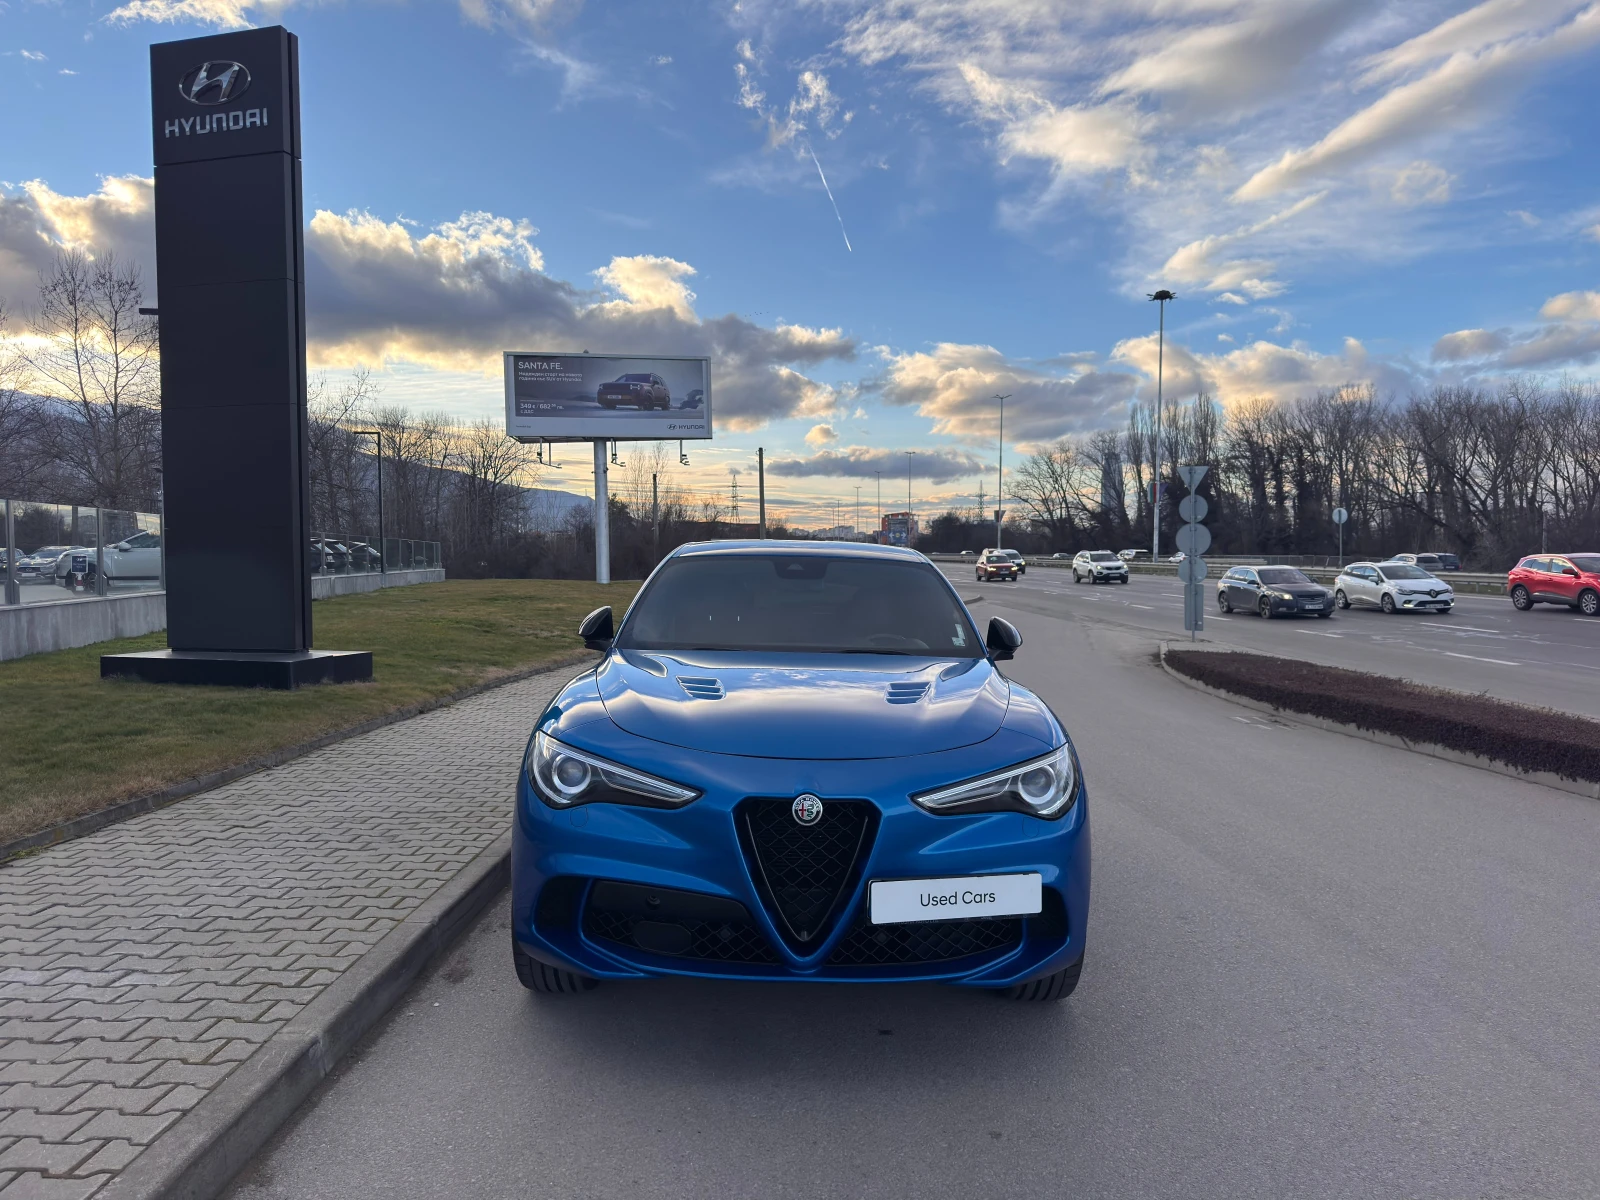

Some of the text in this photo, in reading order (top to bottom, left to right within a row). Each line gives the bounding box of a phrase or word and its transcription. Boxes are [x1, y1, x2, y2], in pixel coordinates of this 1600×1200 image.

[165, 107, 268, 138] HYUNDAI
[518, 361, 563, 370] SANTA FE.
[920, 890, 996, 907] Used Cars
